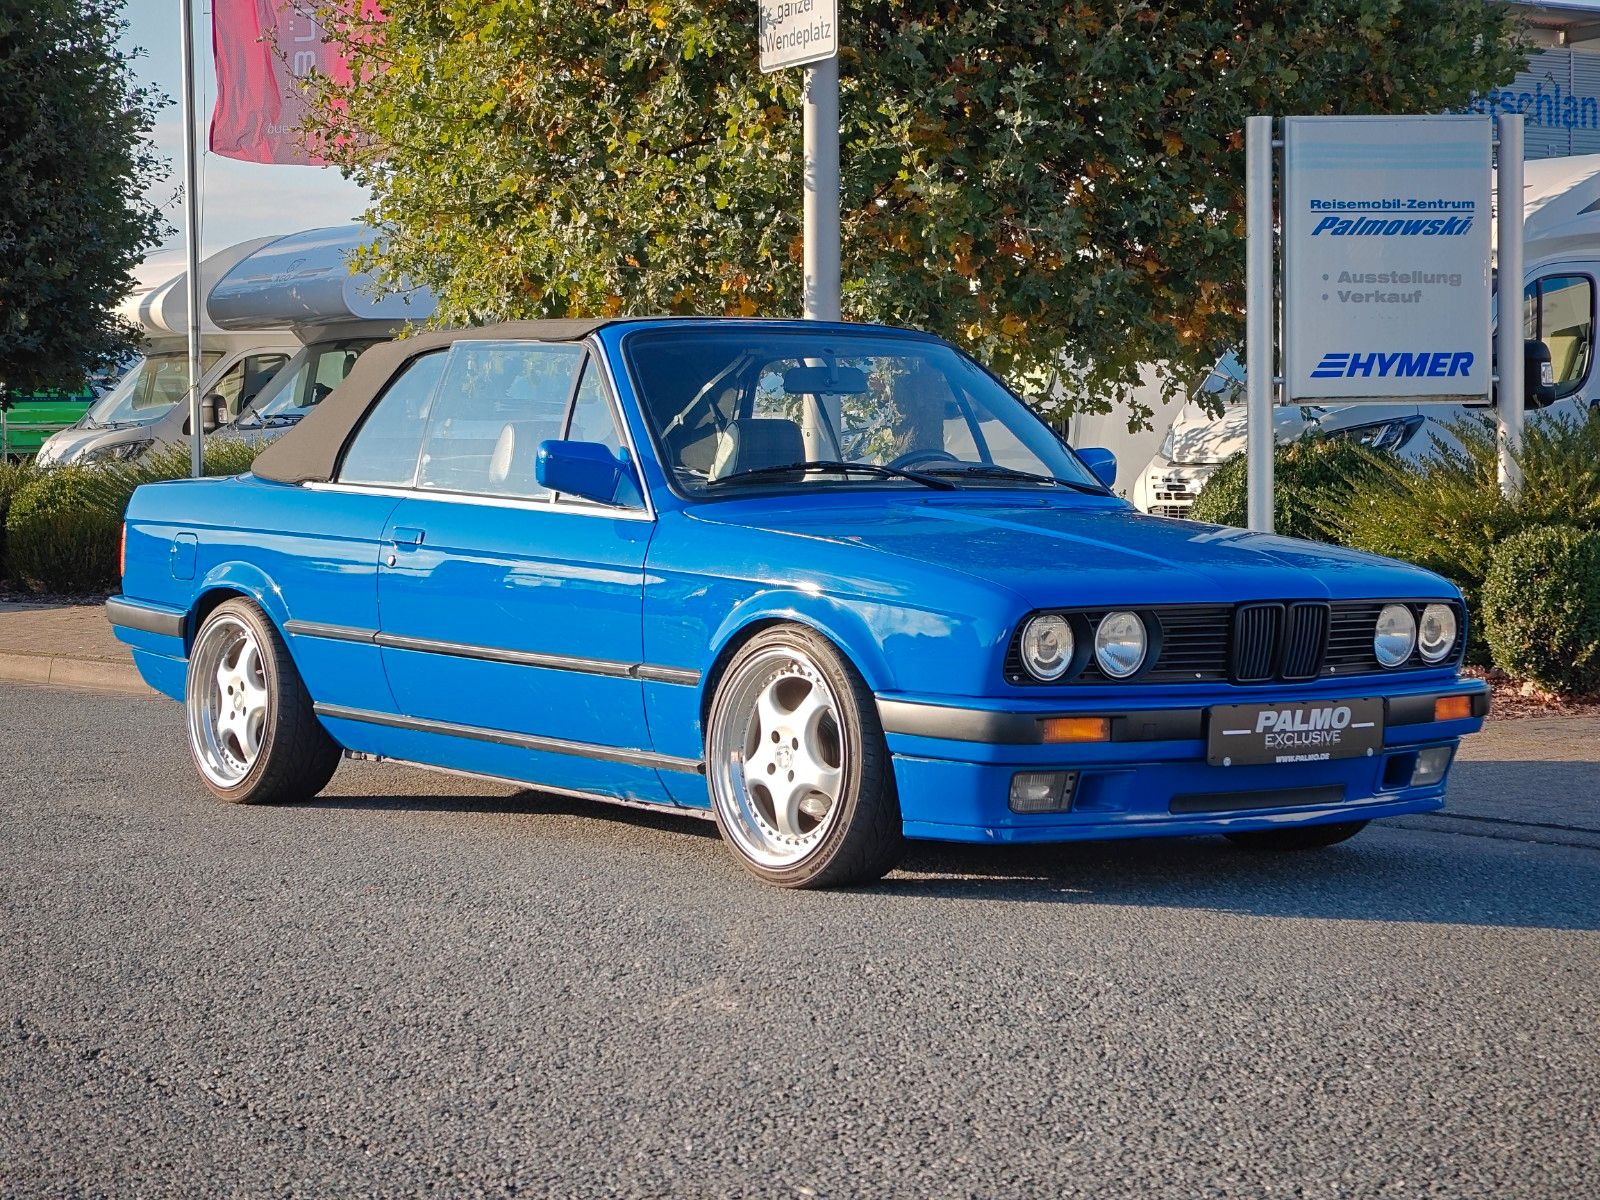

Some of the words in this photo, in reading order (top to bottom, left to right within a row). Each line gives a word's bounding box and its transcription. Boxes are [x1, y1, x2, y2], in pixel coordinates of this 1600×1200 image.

[765, 21, 832, 53] Wendeplatz
[1310, 198, 1476, 210] Reisemobil-Zentrum
[1311, 216, 1474, 236] Palmowski
[1337, 270, 1463, 287] Ausstellung
[1337, 289, 1423, 304] Verkauf
[1345, 351, 1475, 378] HYMER
[1255, 706, 1352, 733] PALMO
[1264, 730, 1342, 746] EXCLUSIVE
[1275, 752, 1331, 764] WWW.PALMO.DE
